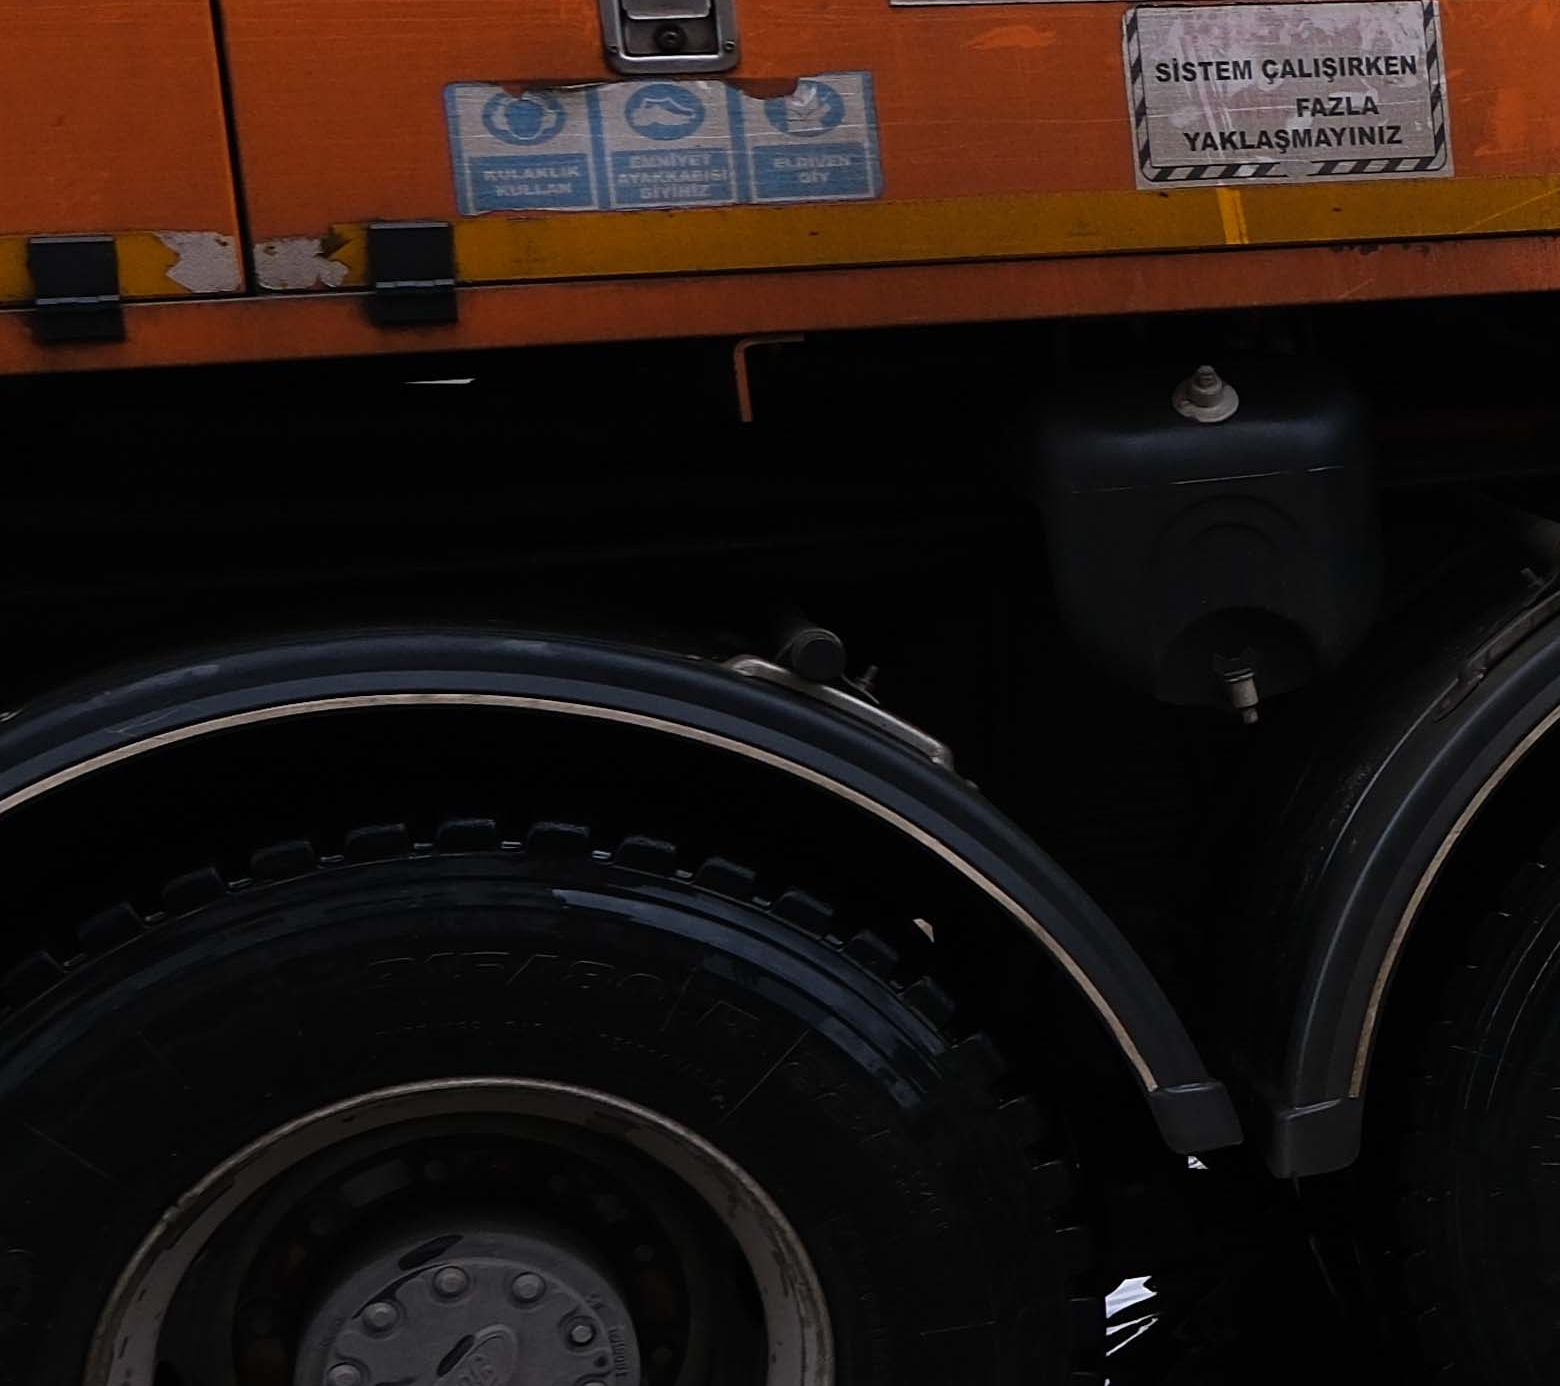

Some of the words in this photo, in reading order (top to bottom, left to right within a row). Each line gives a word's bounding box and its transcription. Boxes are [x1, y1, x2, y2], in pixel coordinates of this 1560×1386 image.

[1155, 56, 1252, 84] SİSTEM
[1262, 54, 1417, 85] ÇALIŞIRKEN
[1296, 95, 1380, 118] FAZLA
[1183, 125, 1403, 155] YAKLAŞMAYINIZ
